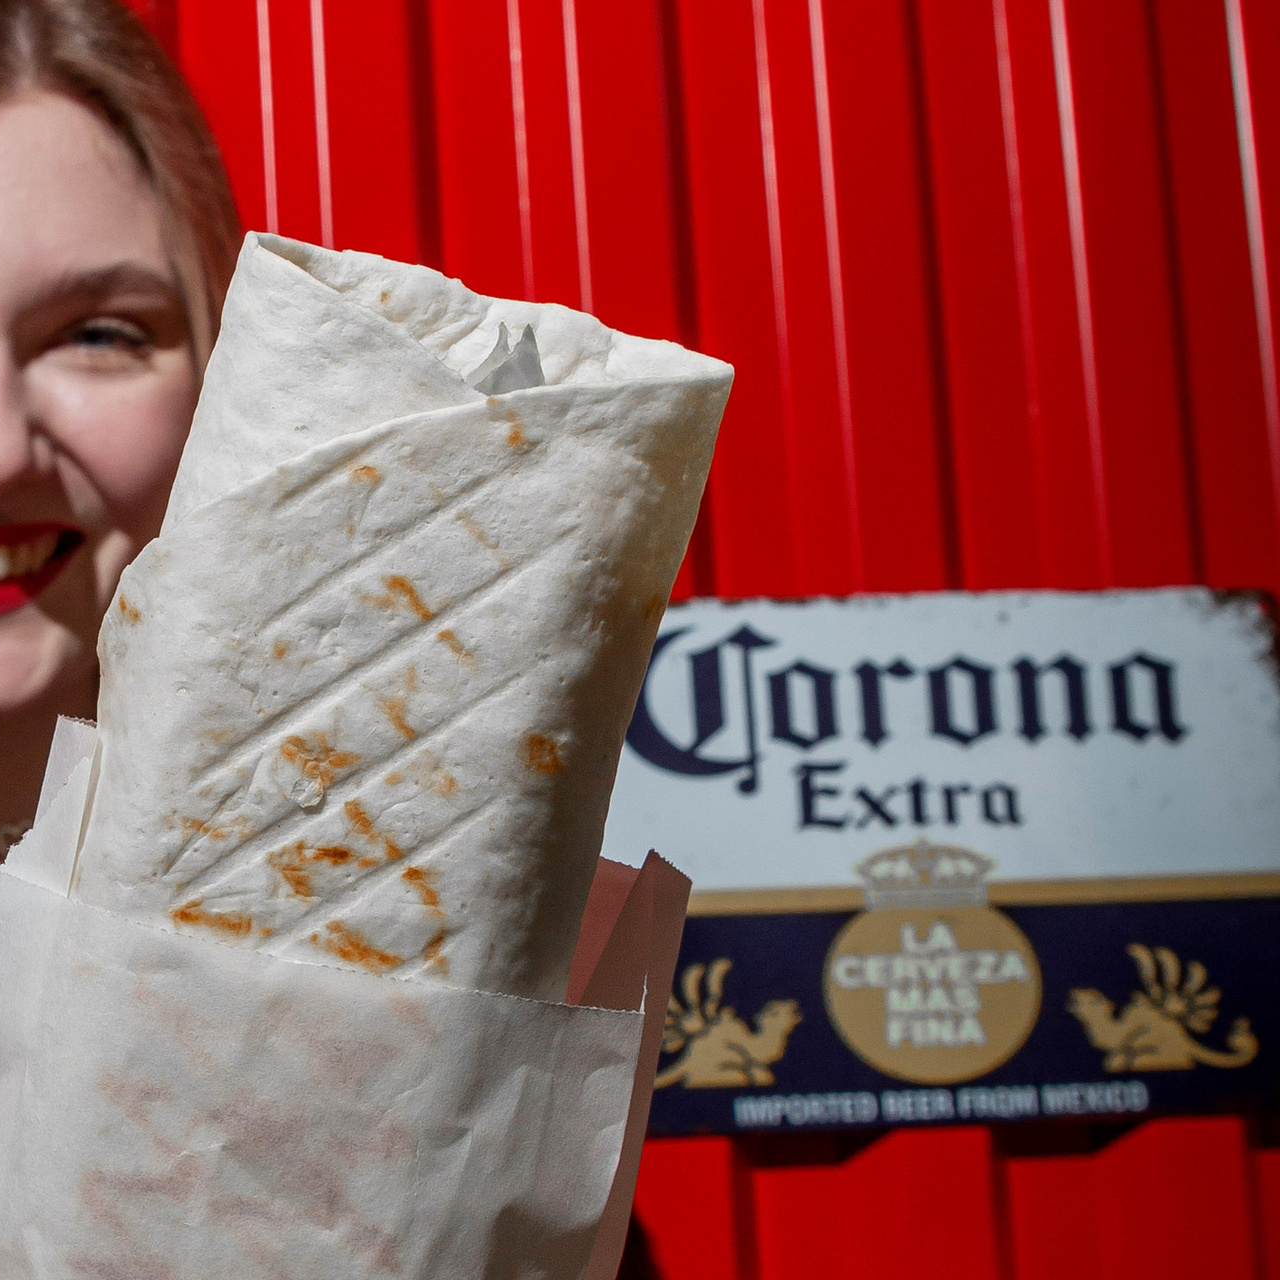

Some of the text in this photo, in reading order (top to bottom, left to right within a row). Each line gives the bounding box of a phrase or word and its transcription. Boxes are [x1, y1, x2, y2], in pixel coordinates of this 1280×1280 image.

[624, 623, 1188, 796] Corona
[792, 759, 1024, 832] Extra
[900, 920, 959, 954] LA
[832, 950, 1031, 989] CERVEZA
[885, 1015, 988, 1049] FINA
[733, 1079, 1150, 1128] IMPORTED BEER FROM MEXICO
